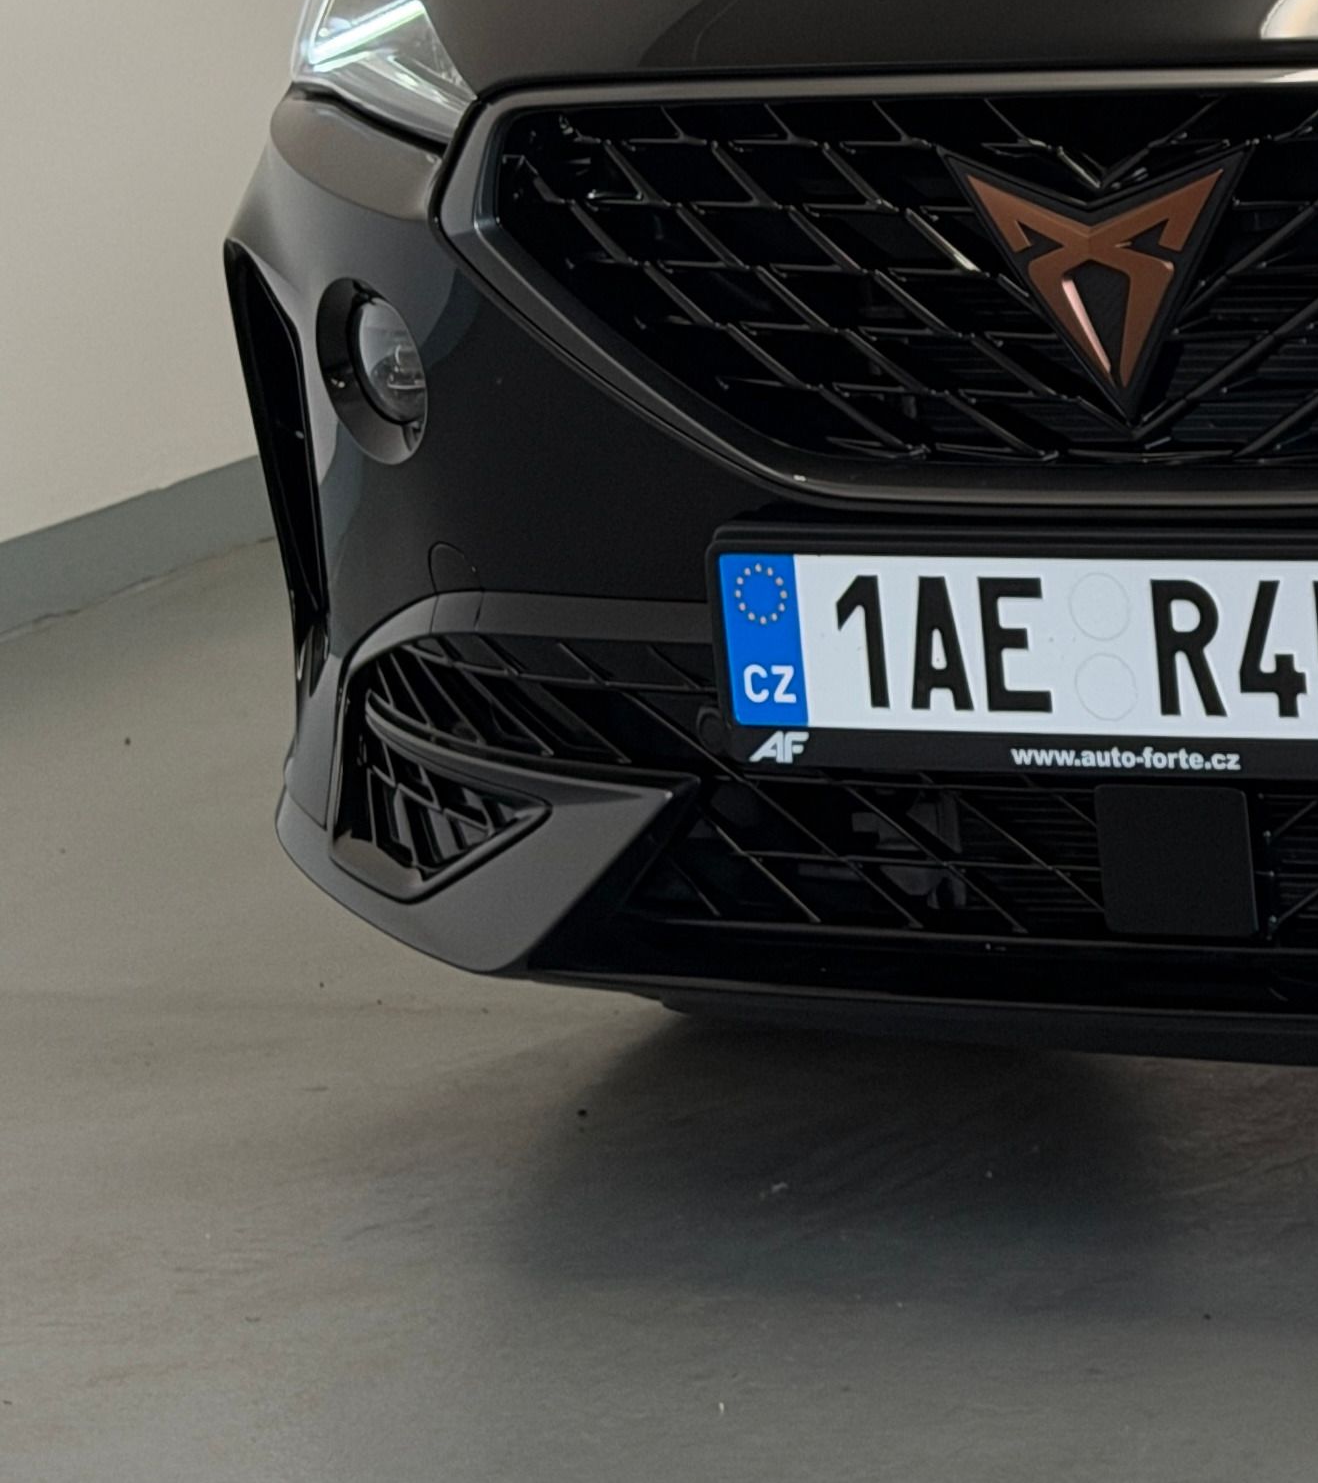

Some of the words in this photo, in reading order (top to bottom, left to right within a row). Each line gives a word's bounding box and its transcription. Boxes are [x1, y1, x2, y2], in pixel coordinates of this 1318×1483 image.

[836, 575, 1053, 713] 1AE
[743, 663, 797, 704] CZ
[749, 730, 810, 764] AF
[1010, 746, 1242, 771] www.auto-forte.cz
